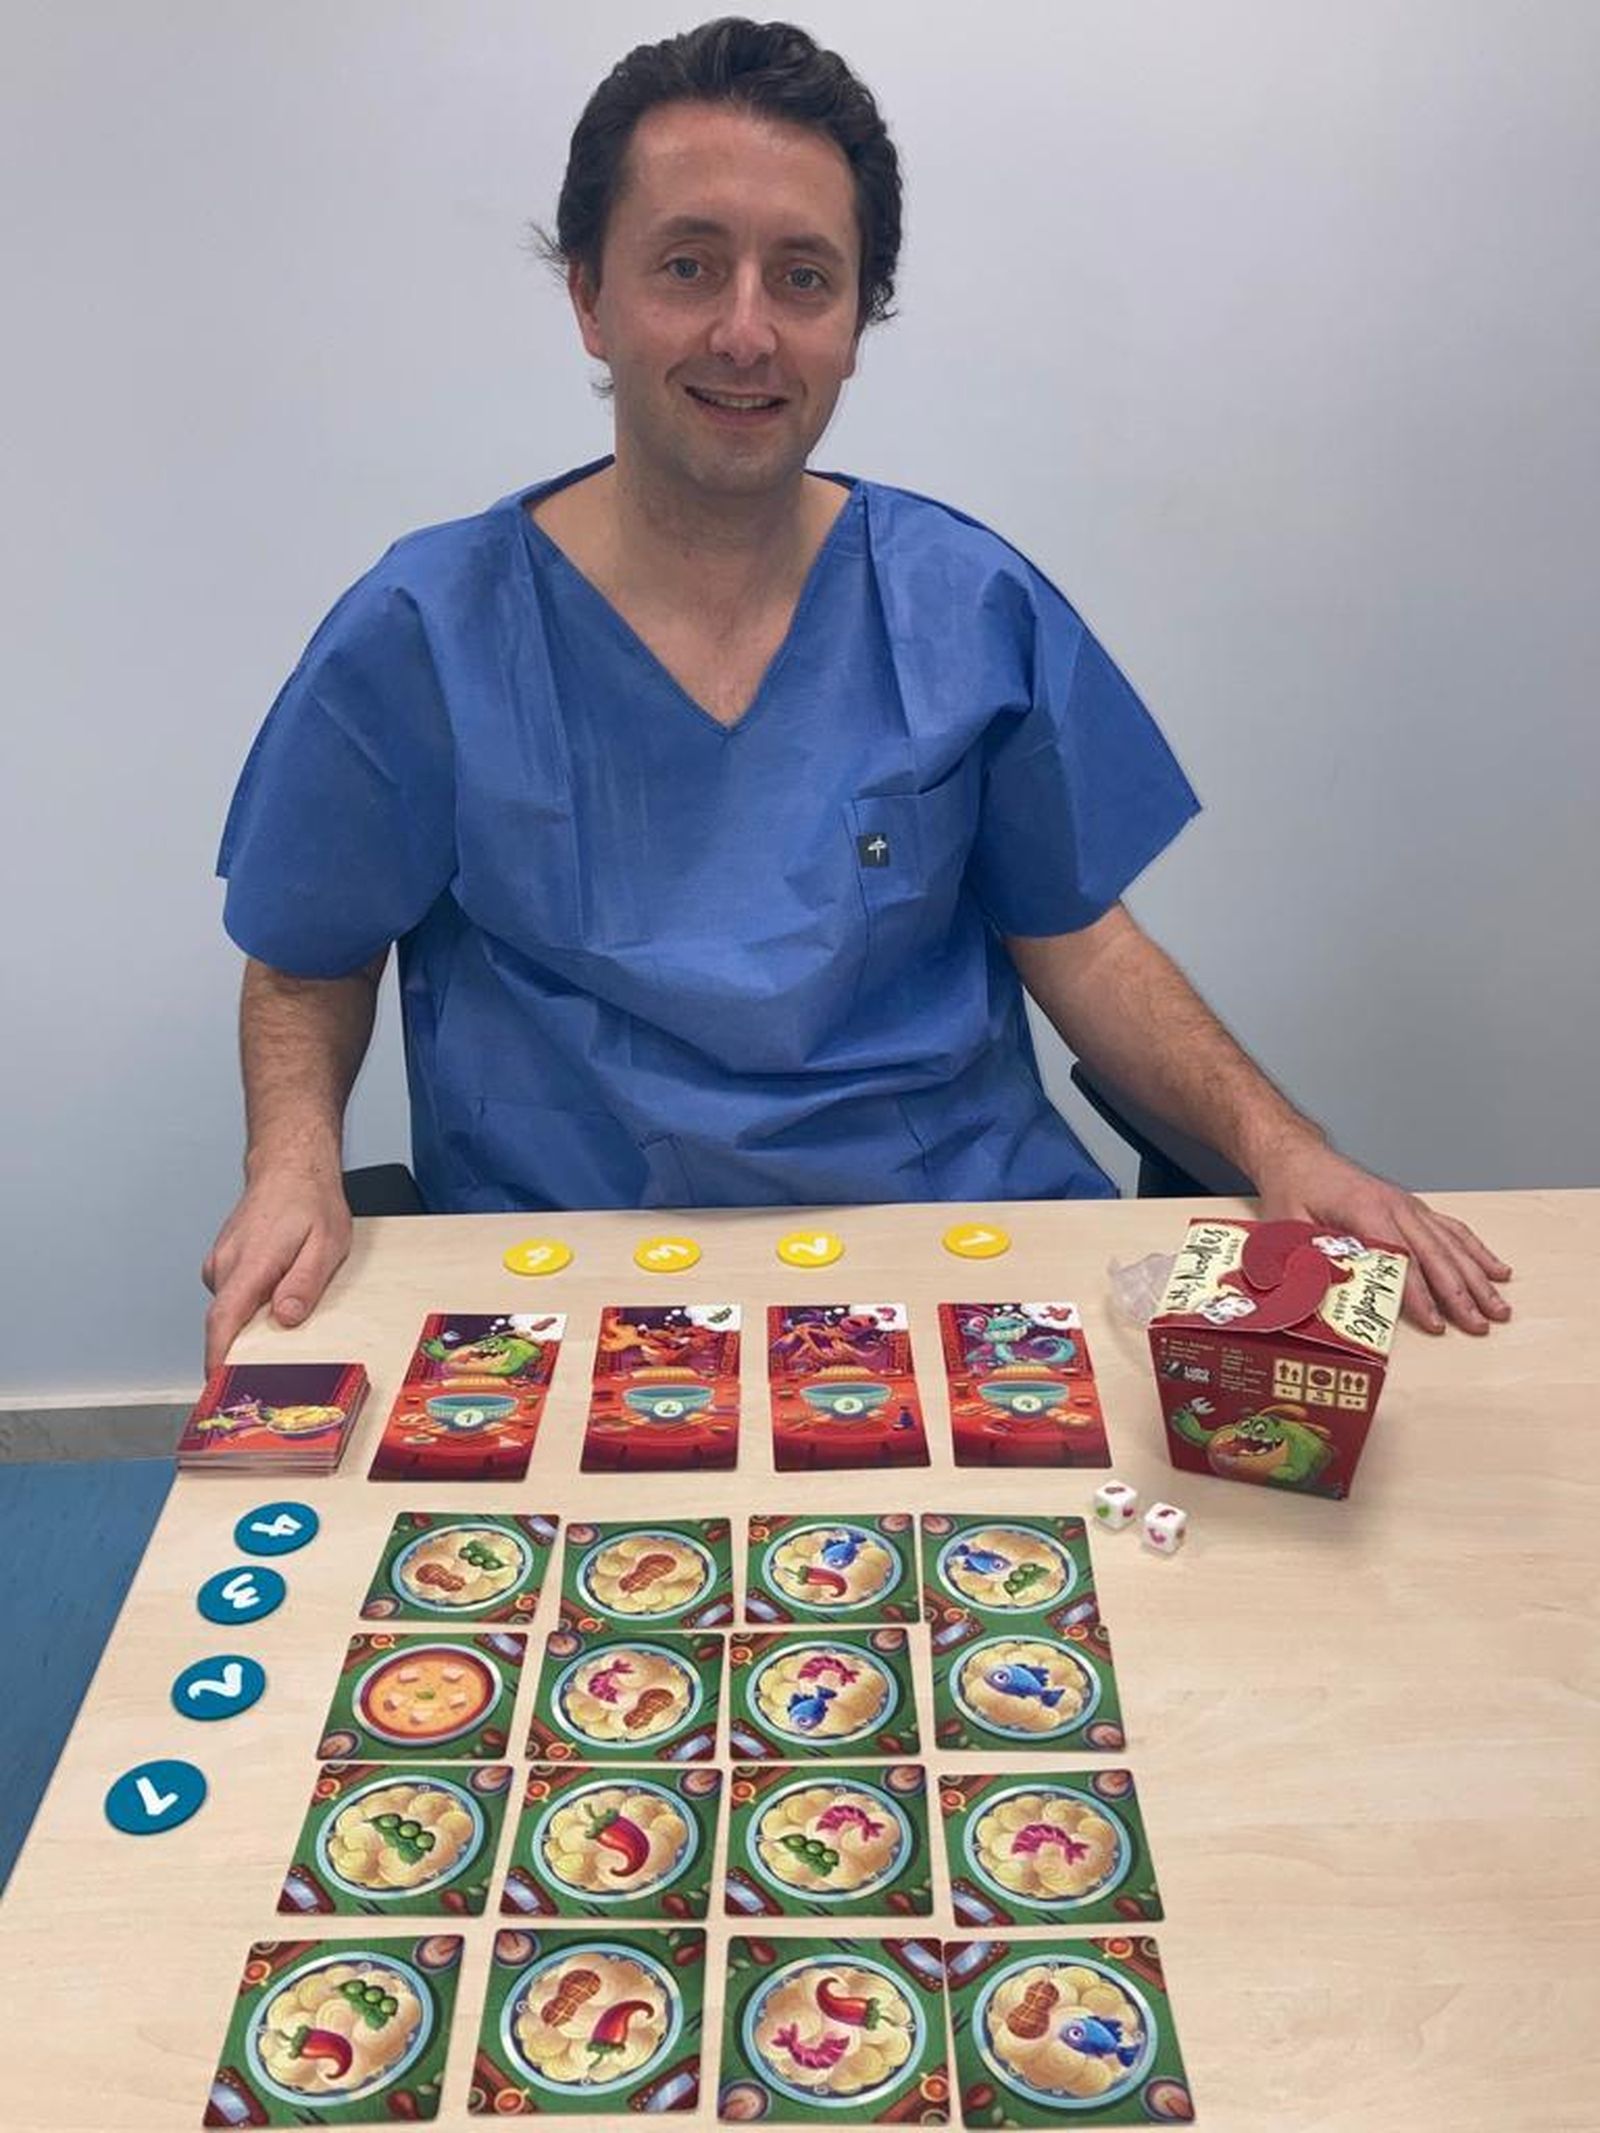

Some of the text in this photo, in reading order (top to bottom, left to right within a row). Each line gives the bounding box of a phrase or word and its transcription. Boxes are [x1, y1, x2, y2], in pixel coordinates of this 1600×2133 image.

[789, 1237, 828, 1256] 2
[957, 1230, 996, 1248] 1
[646, 1244, 689, 1261] 3
[250, 1513, 302, 1537] 4
[221, 1572, 261, 1610] 3
[187, 1662, 244, 1701] 2
[135, 1775, 180, 1817] 1
